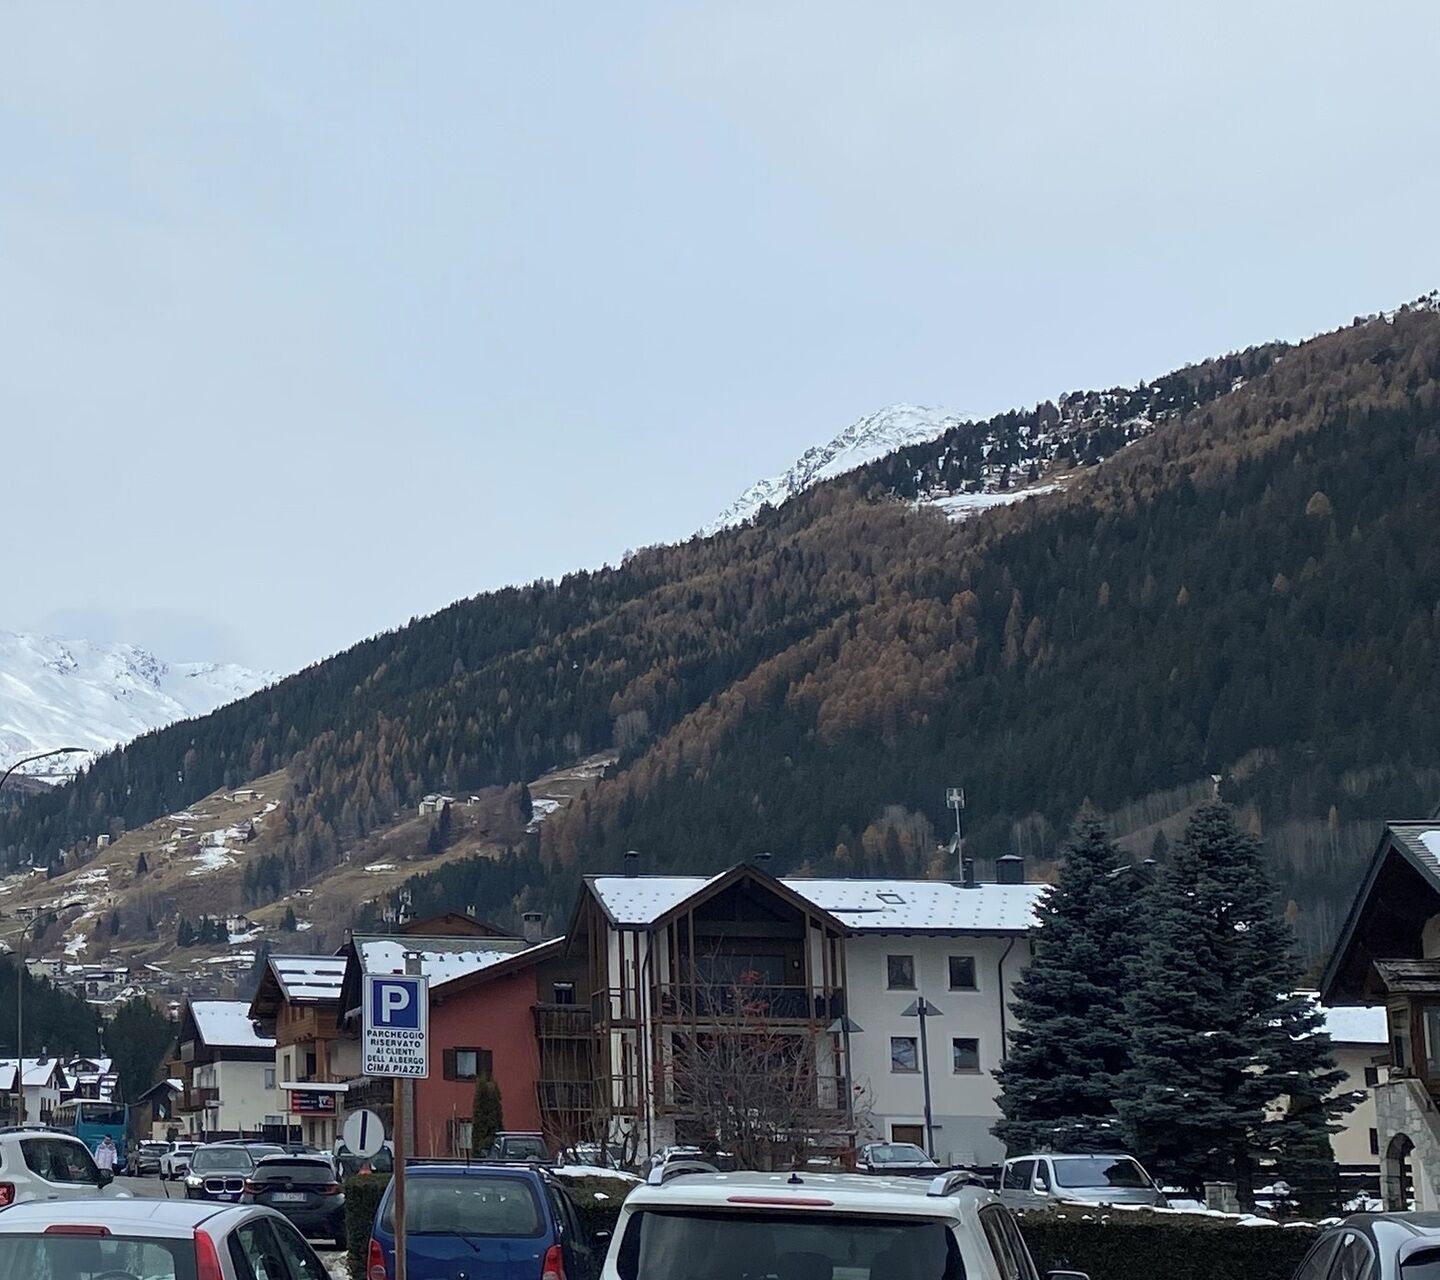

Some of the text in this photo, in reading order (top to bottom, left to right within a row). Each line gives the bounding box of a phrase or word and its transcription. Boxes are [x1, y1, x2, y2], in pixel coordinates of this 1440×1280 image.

[382, 984, 410, 1023] P
[366, 1029, 425, 1040] PARCHEGGIO
[370, 1039, 421, 1049] RISERVATO
[376, 1047, 416, 1057] AI CLIENTI
[367, 1063, 425, 1075] CIMA PIAZZI
